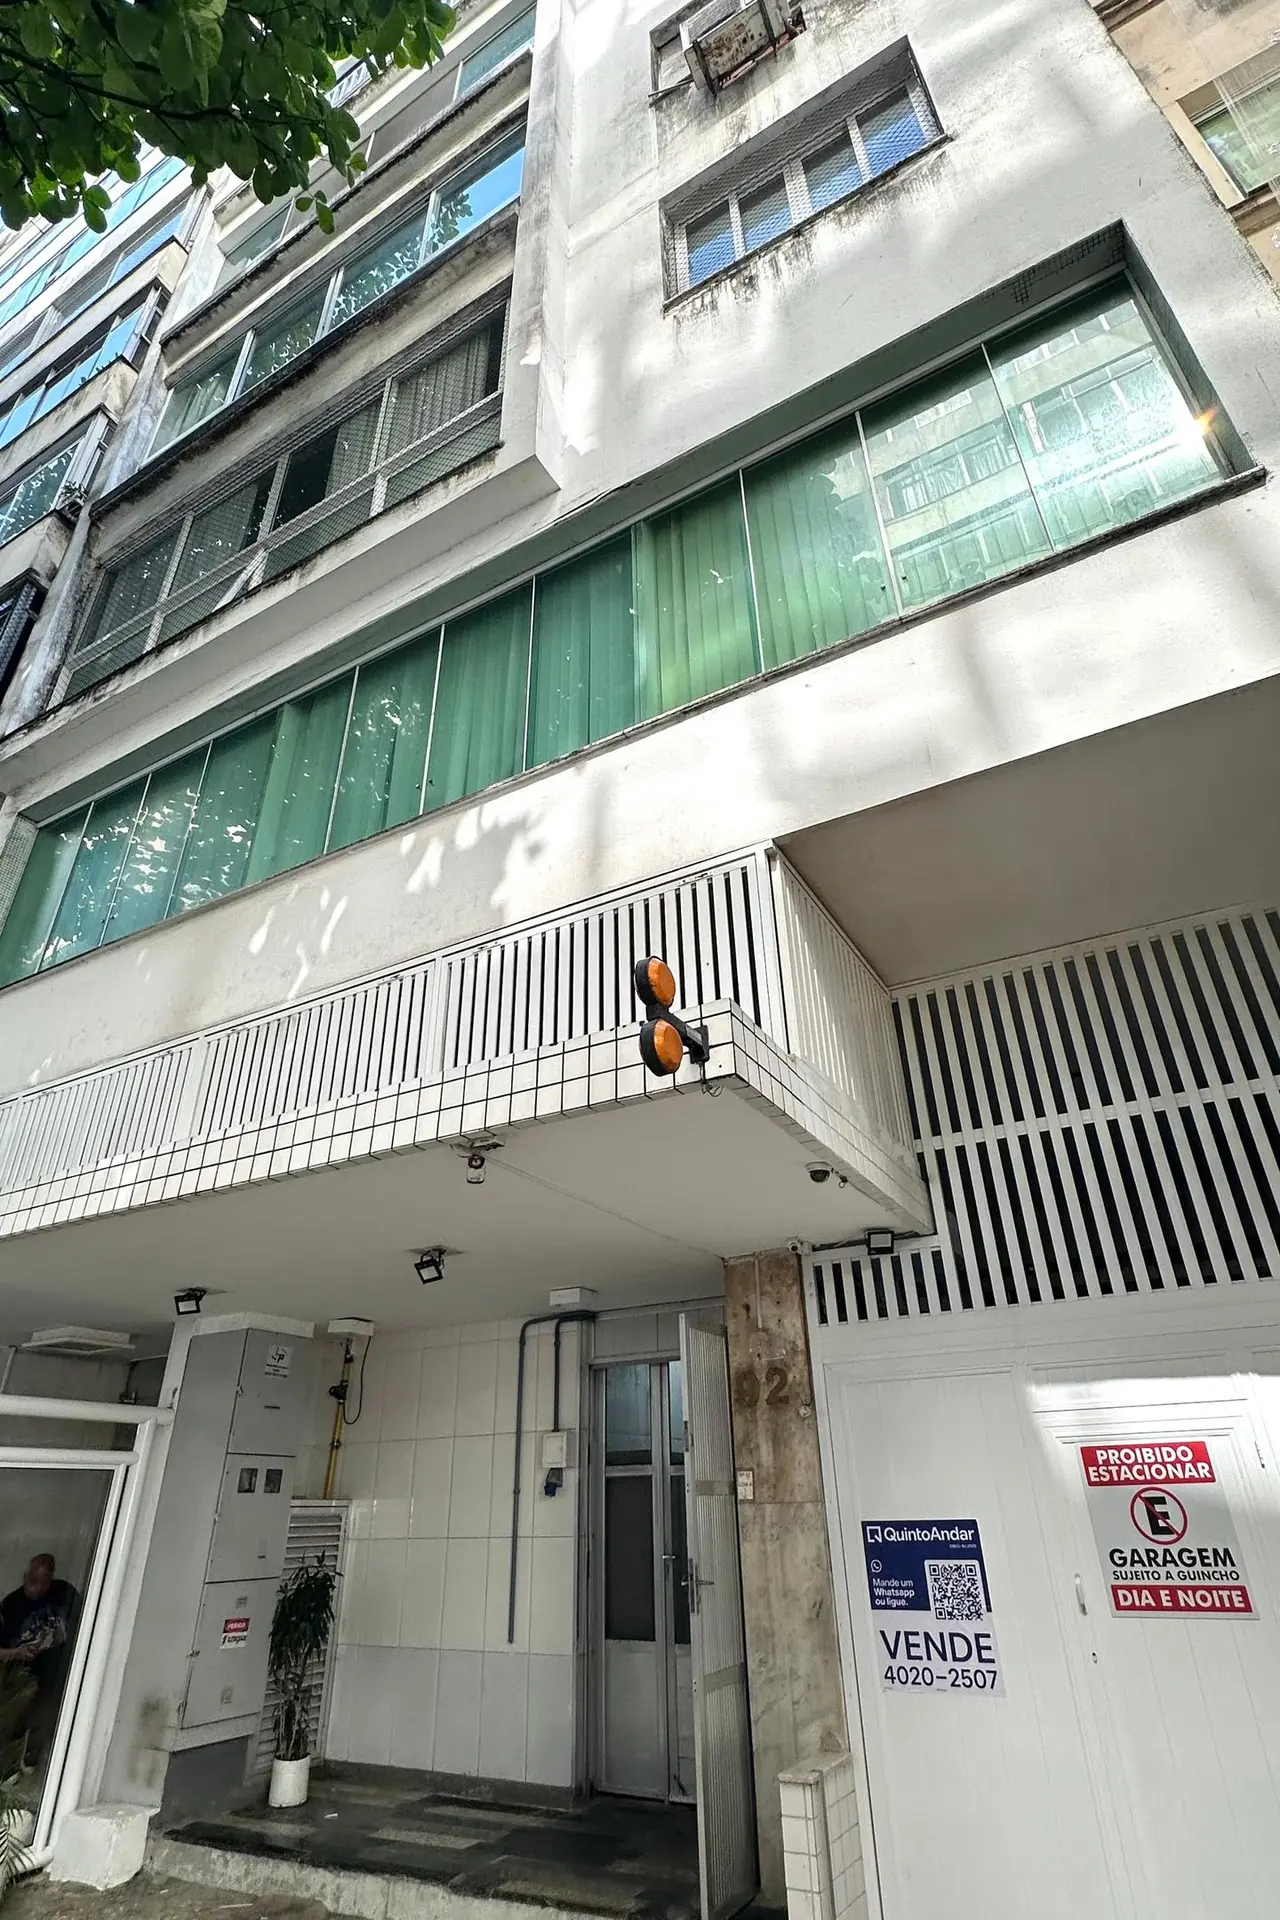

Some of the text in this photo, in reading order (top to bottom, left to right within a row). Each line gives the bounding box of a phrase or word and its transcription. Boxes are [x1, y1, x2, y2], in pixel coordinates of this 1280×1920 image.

[735, 1366, 789, 1407] 92
[1095, 1446, 1193, 1464] PROIBIDO
[1088, 1463, 1212, 1482] ESTACIONAR
[884, 1526, 975, 1542] QuintoAndar
[1109, 1547, 1236, 1568] GARAGEM
[873, 1578, 900, 1587] Mande
[1112, 1570, 1240, 1581] SUJEITO A GUINCHO
[874, 1588, 915, 1598] Whatsapp
[1117, 1589, 1245, 1608] DIA E NOITE
[886, 1597, 909, 1608] ligue.
[879, 1630, 996, 1664] VENDE
[884, 1665, 997, 1689] 4020-2507
